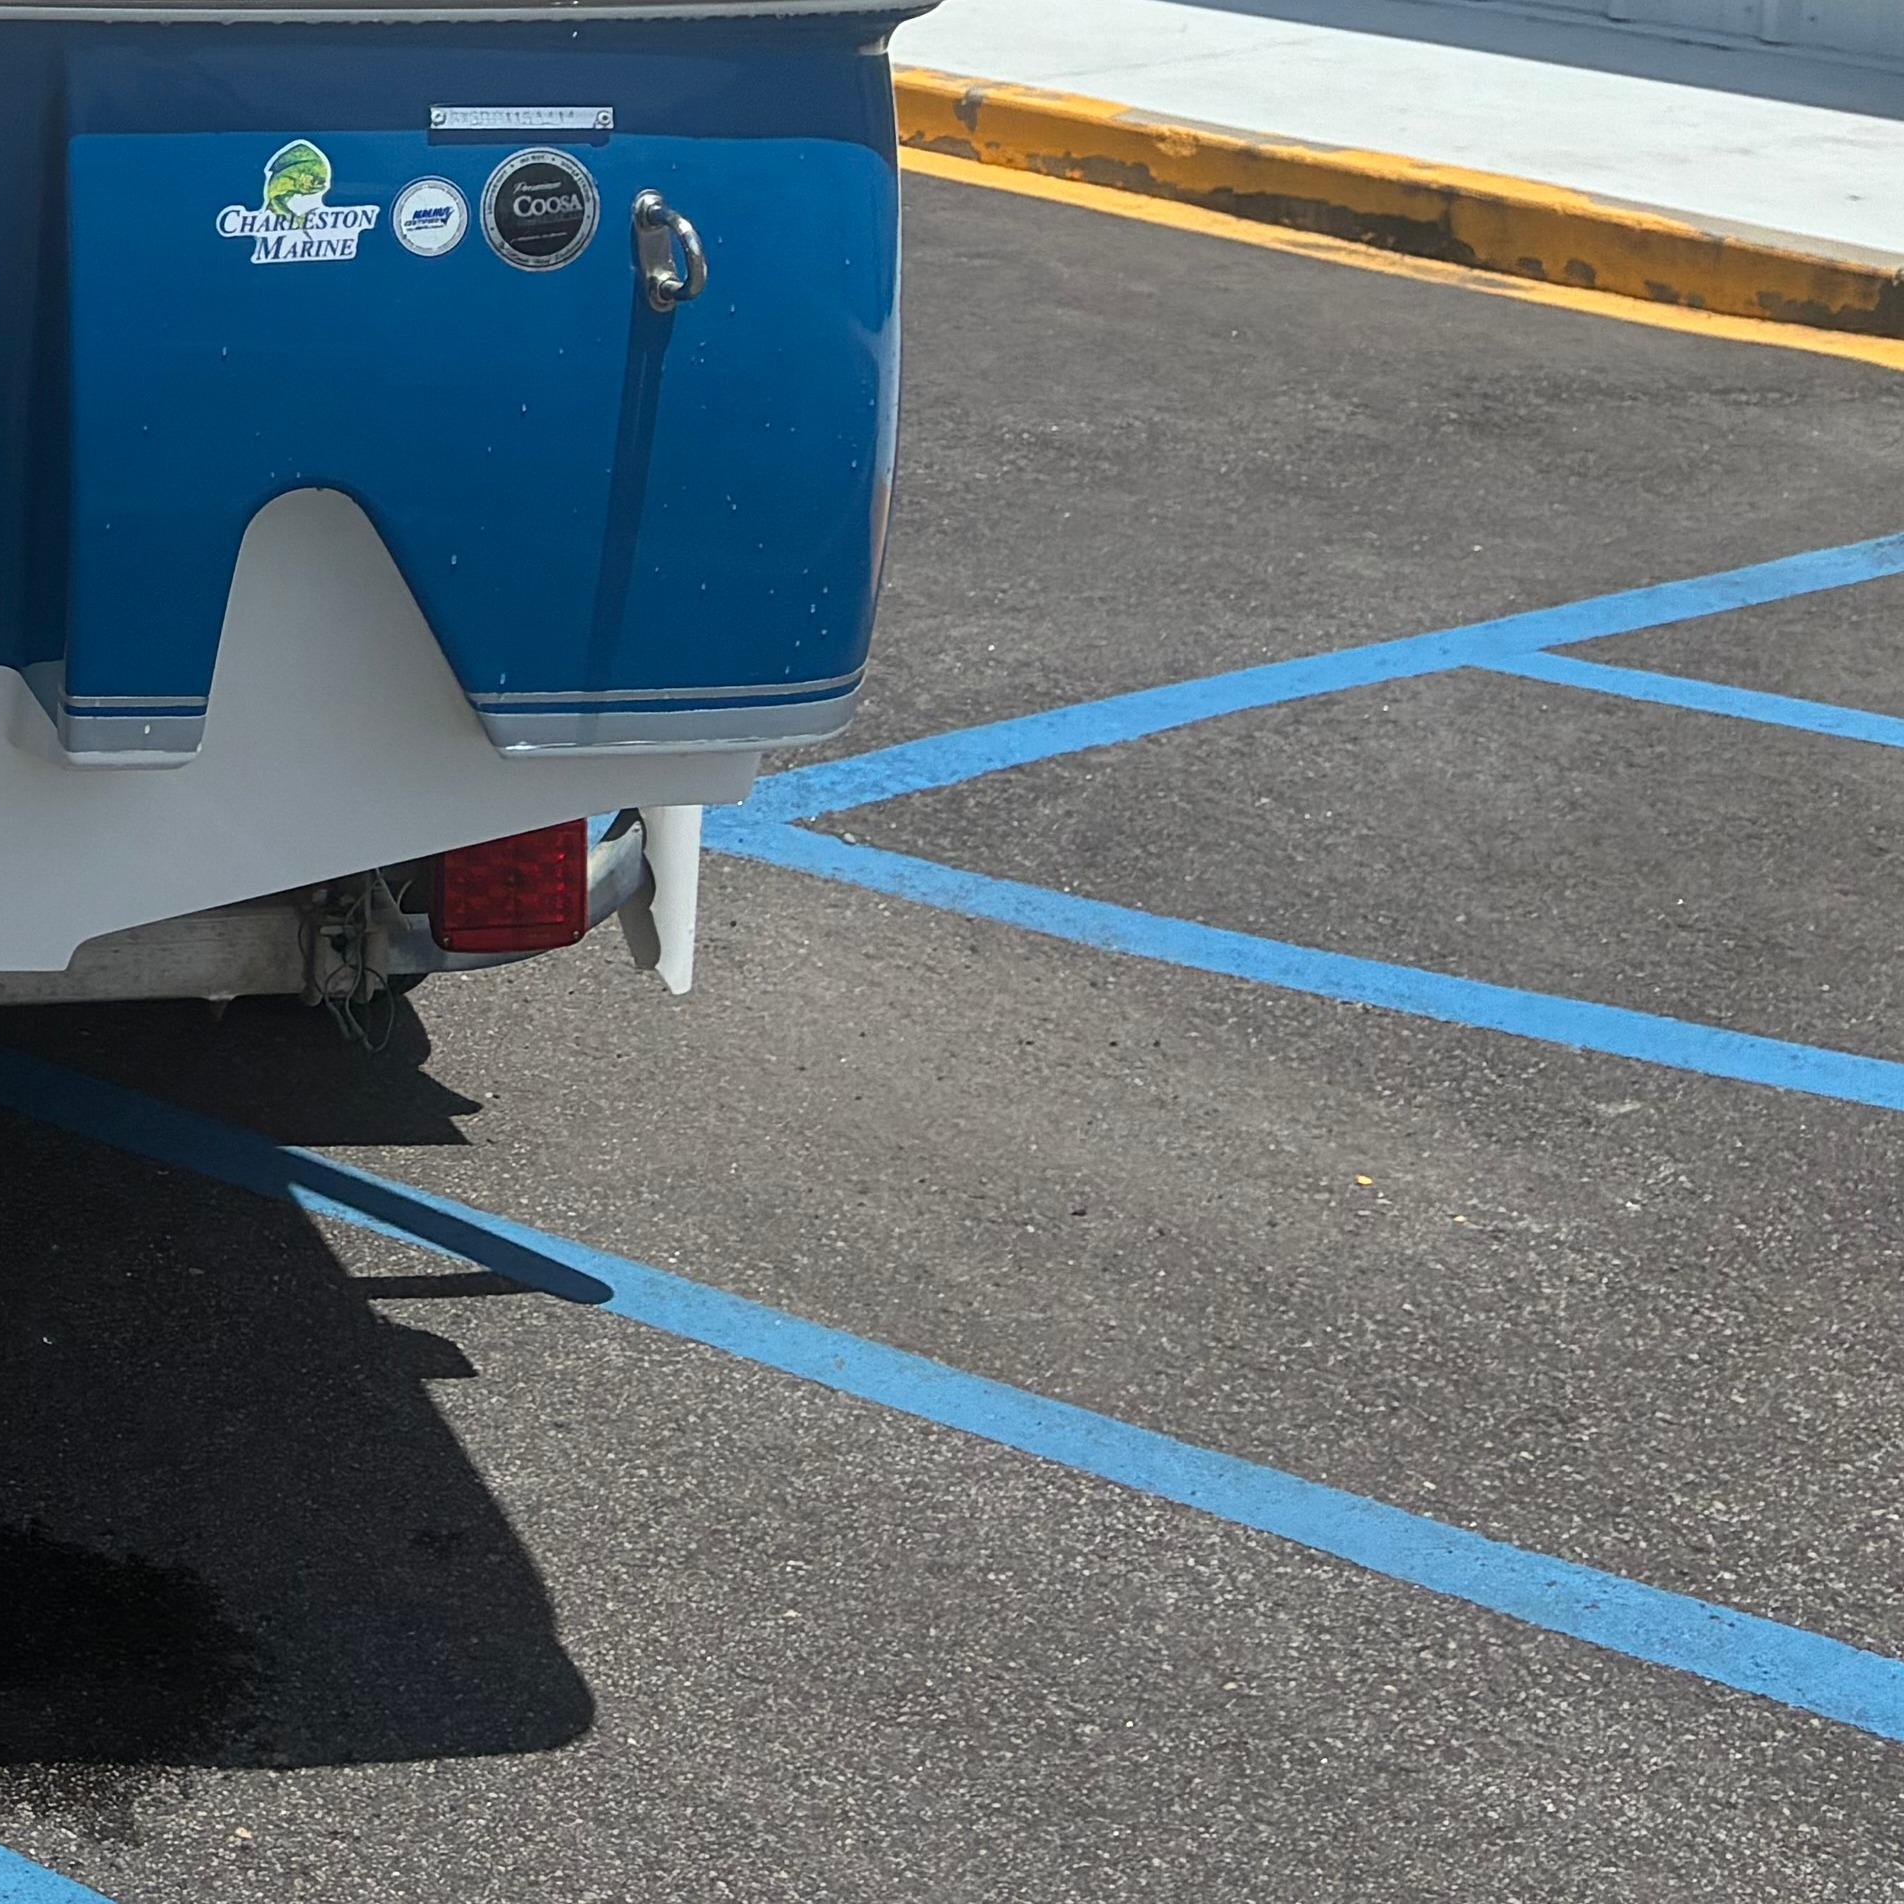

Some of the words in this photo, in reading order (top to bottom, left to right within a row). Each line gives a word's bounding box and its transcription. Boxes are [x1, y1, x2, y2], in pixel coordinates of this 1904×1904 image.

[513, 194, 583, 218] COOSA
[219, 209, 376, 234] CHARLESTON
[256, 234, 356, 261] MARINE
